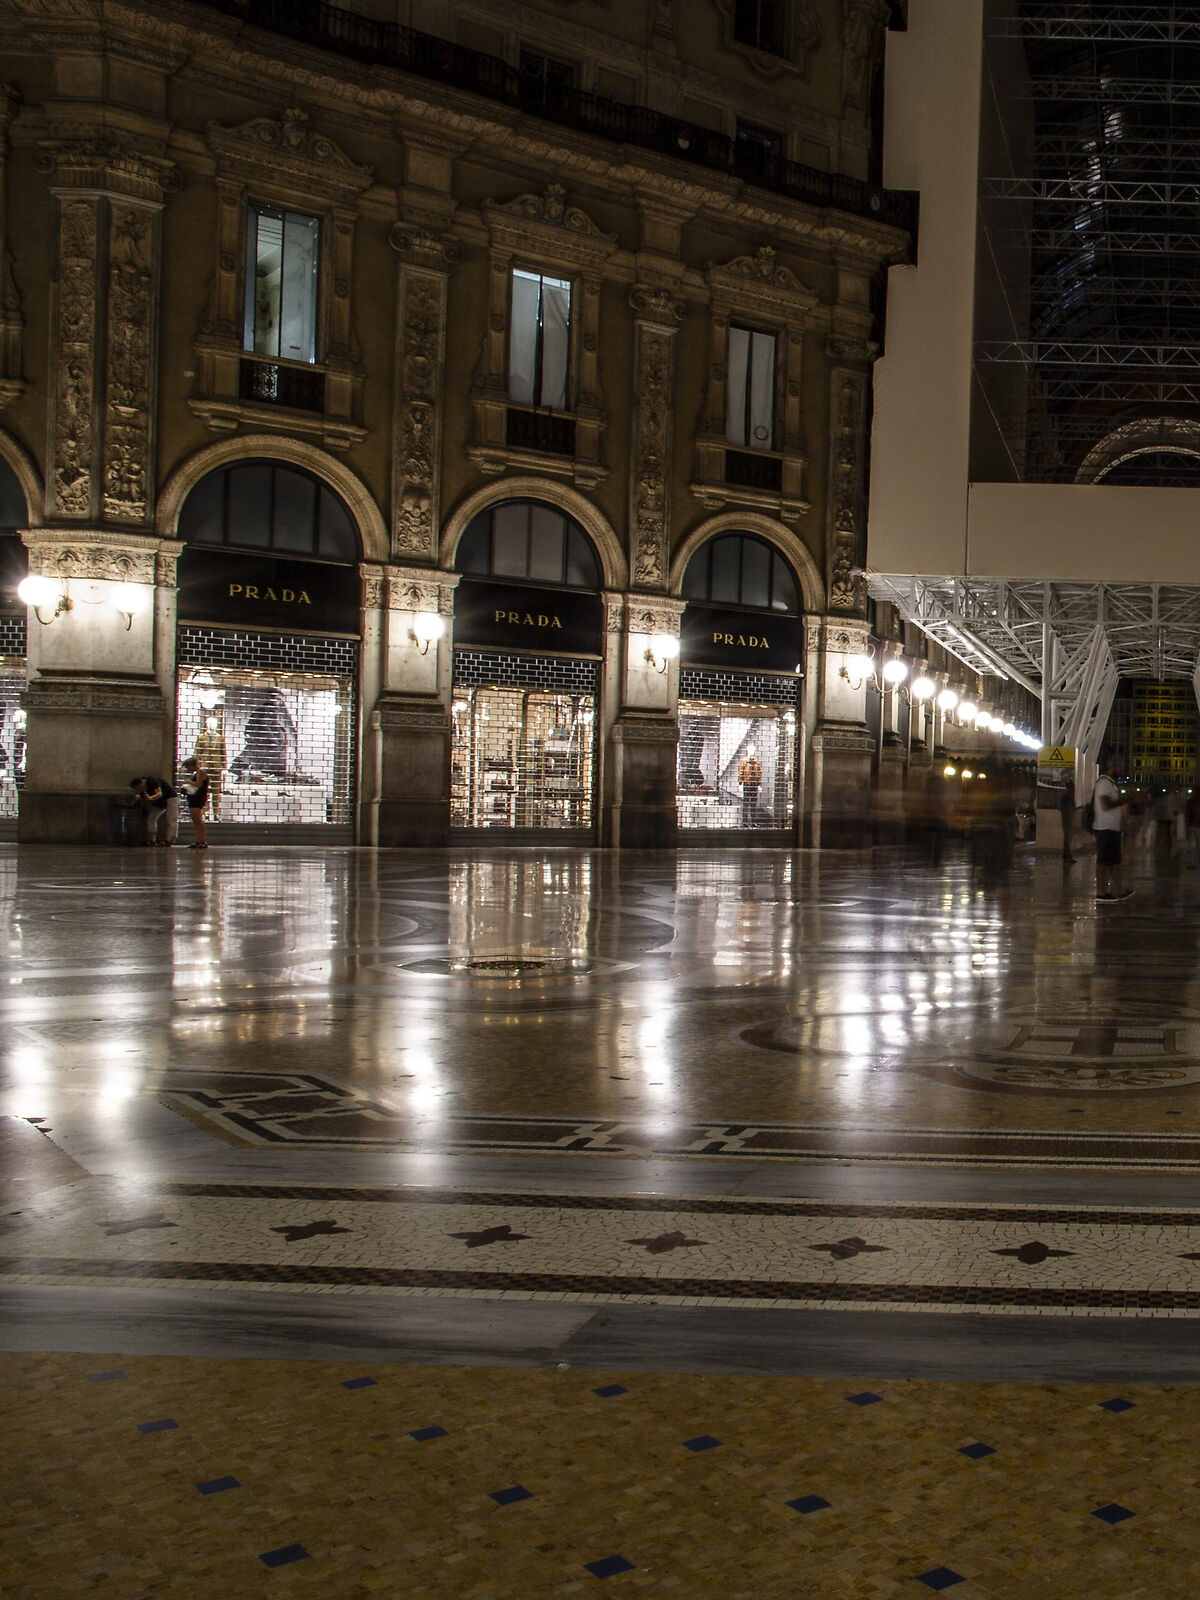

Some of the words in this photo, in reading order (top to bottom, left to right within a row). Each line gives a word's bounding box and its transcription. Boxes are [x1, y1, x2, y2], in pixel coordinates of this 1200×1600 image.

[228, 583, 312, 604] PRADA
[495, 610, 563, 628] PRADA
[713, 632, 770, 648] PRADA
